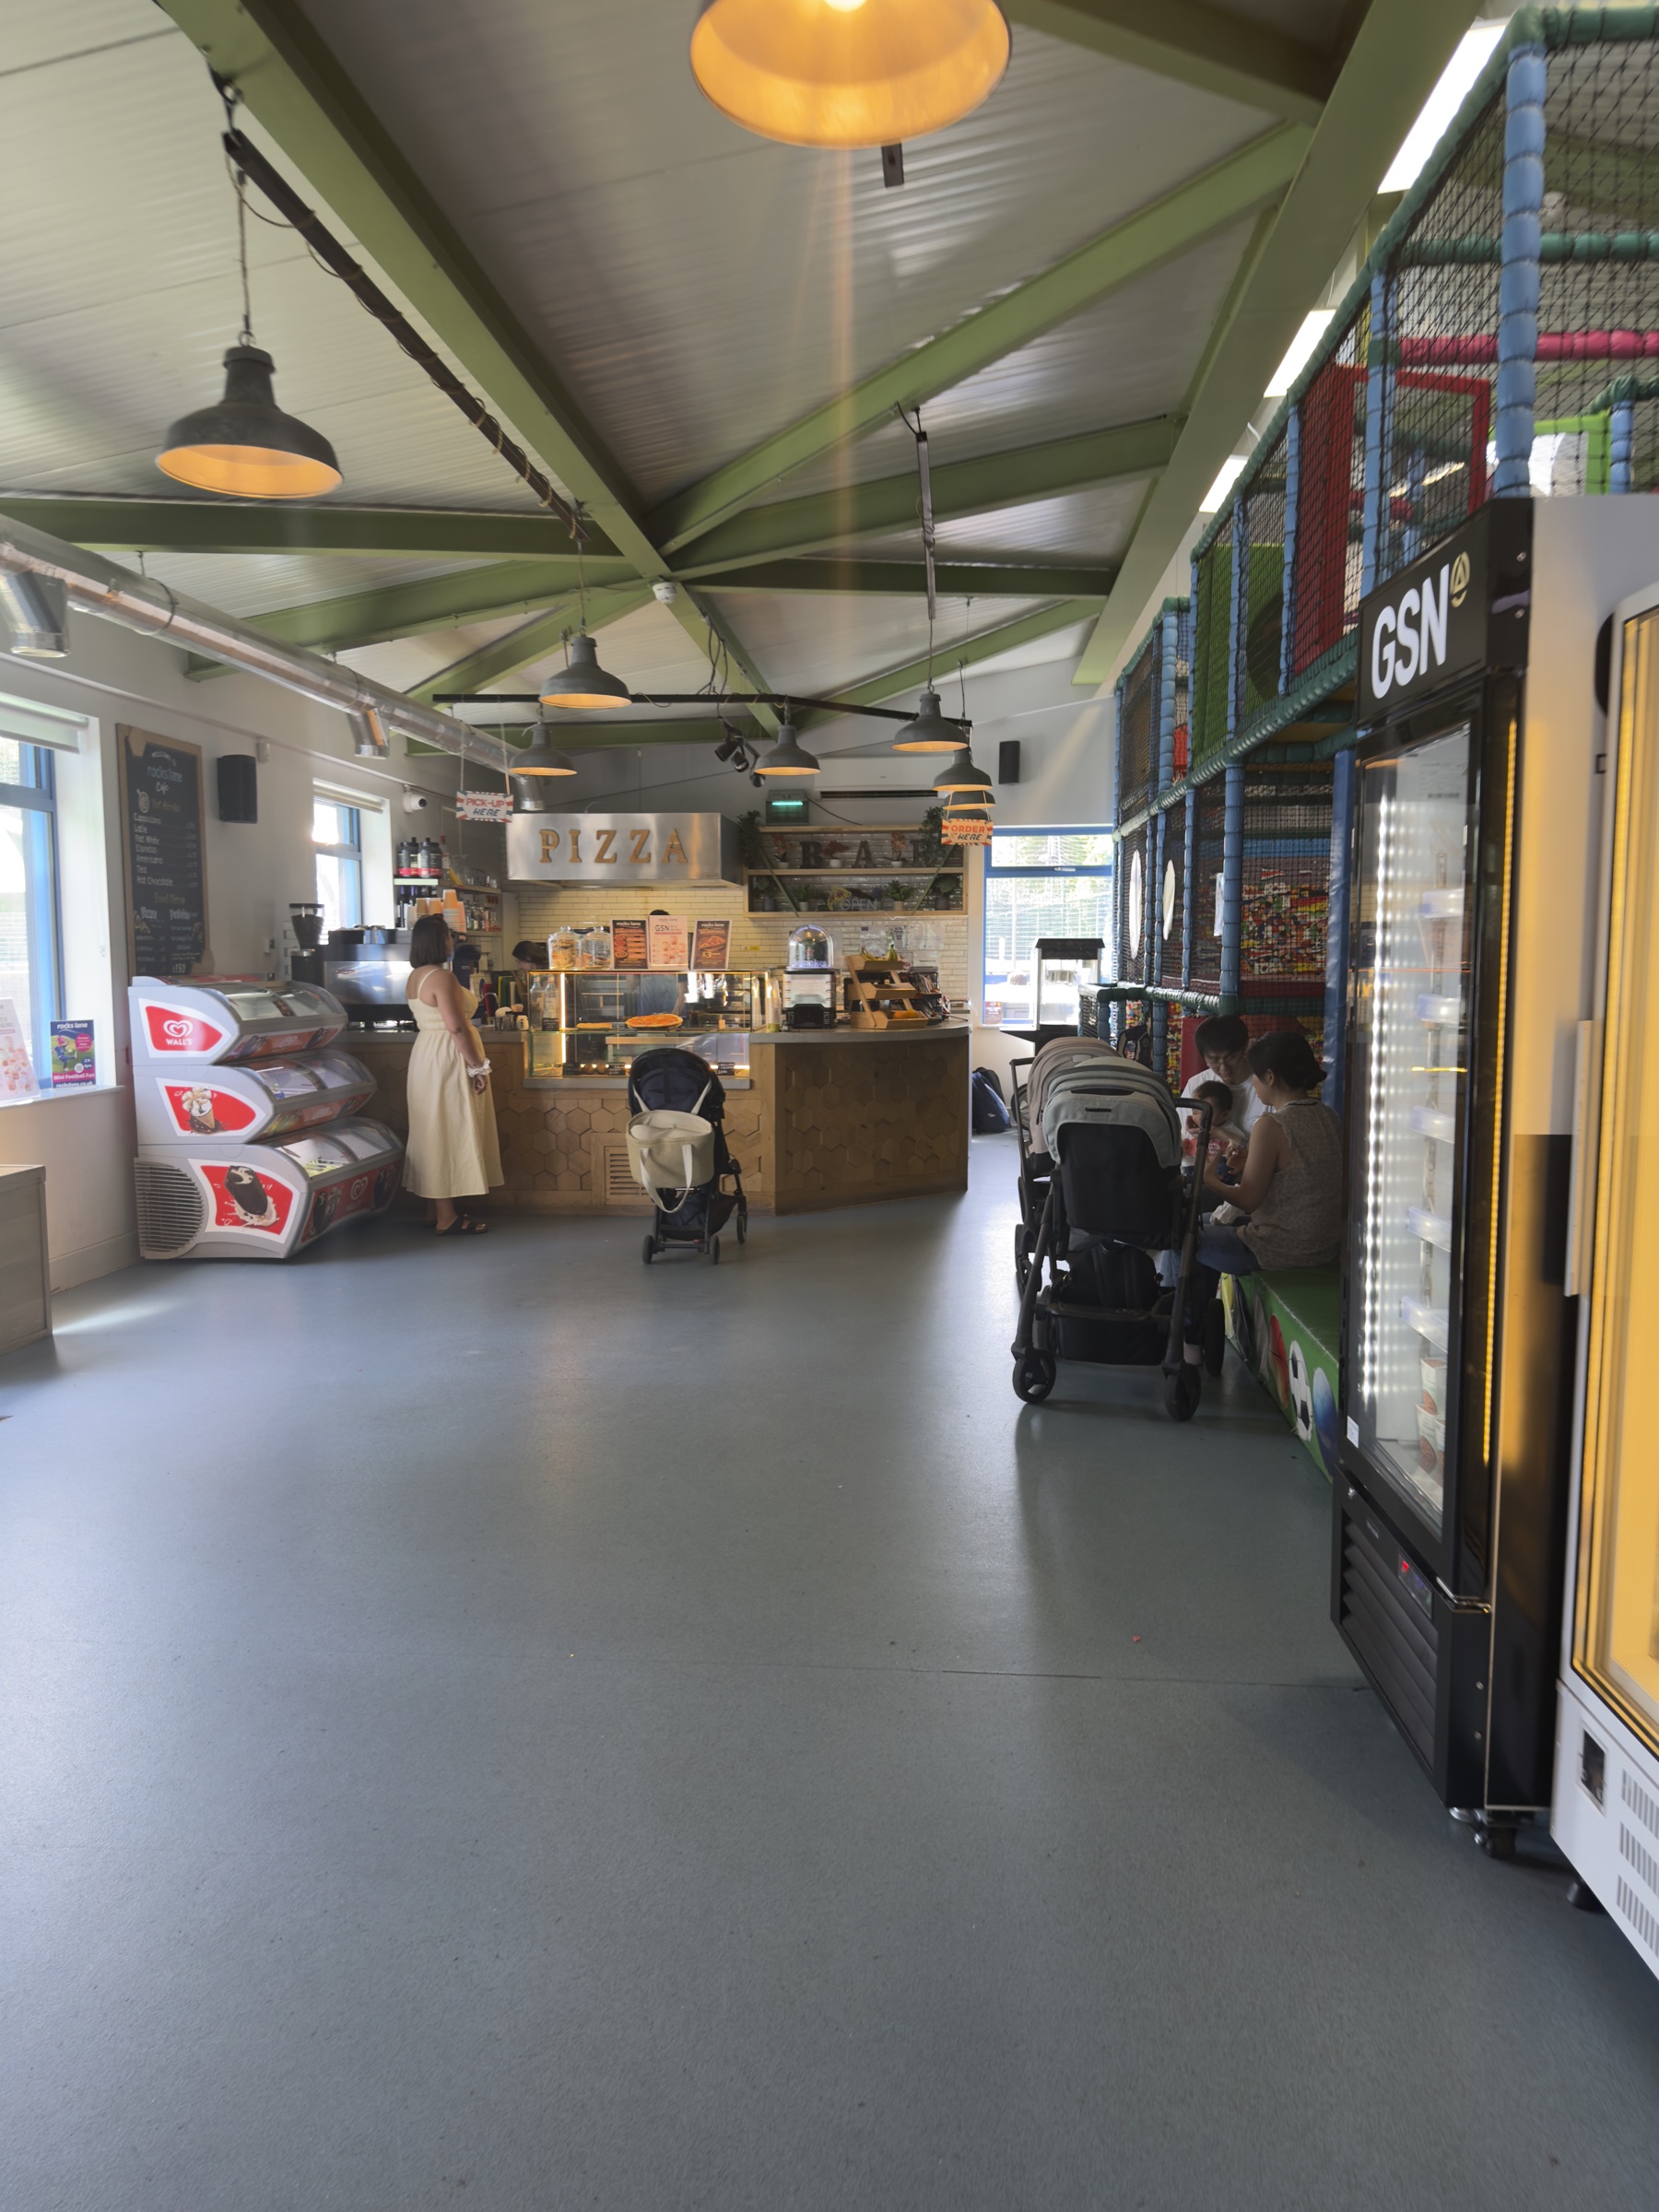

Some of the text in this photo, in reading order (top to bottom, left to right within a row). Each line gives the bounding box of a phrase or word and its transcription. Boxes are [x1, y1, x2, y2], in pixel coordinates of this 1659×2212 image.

[1371, 562, 1450, 700] GSN
[465, 798, 505, 808] PICK-UP
[472, 807, 501, 817] HERE
[950, 825, 985, 833] ORDER
[957, 832, 983, 841] HERE
[538, 829, 688, 864] PIZZA
[136, 865, 147, 874] Tea
[136, 876, 147, 885] Hot
[840, 899, 877, 911] OPEN
